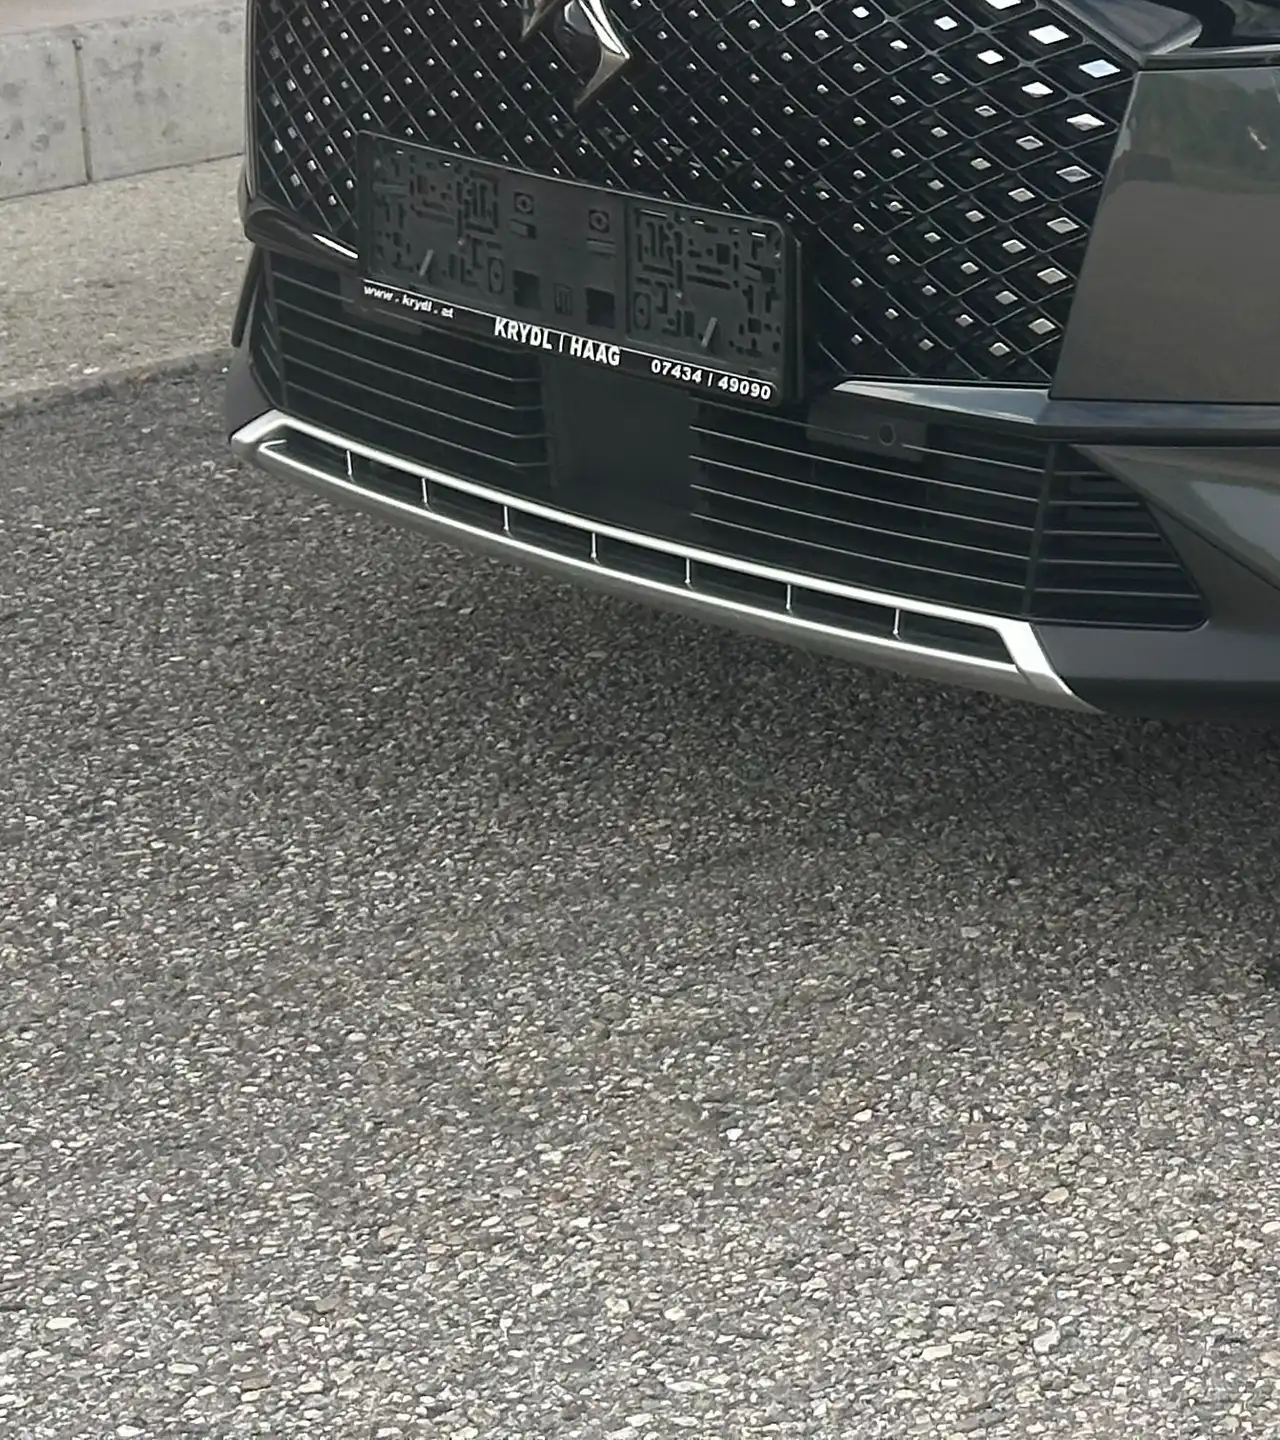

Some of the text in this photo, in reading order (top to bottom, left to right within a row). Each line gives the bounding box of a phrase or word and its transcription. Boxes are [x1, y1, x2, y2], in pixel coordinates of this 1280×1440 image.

[493, 315, 553, 350] KRYDL
[569, 336, 621, 367] HAAG
[650, 359, 703, 385] 07434
[717, 375, 772, 401] 49090
